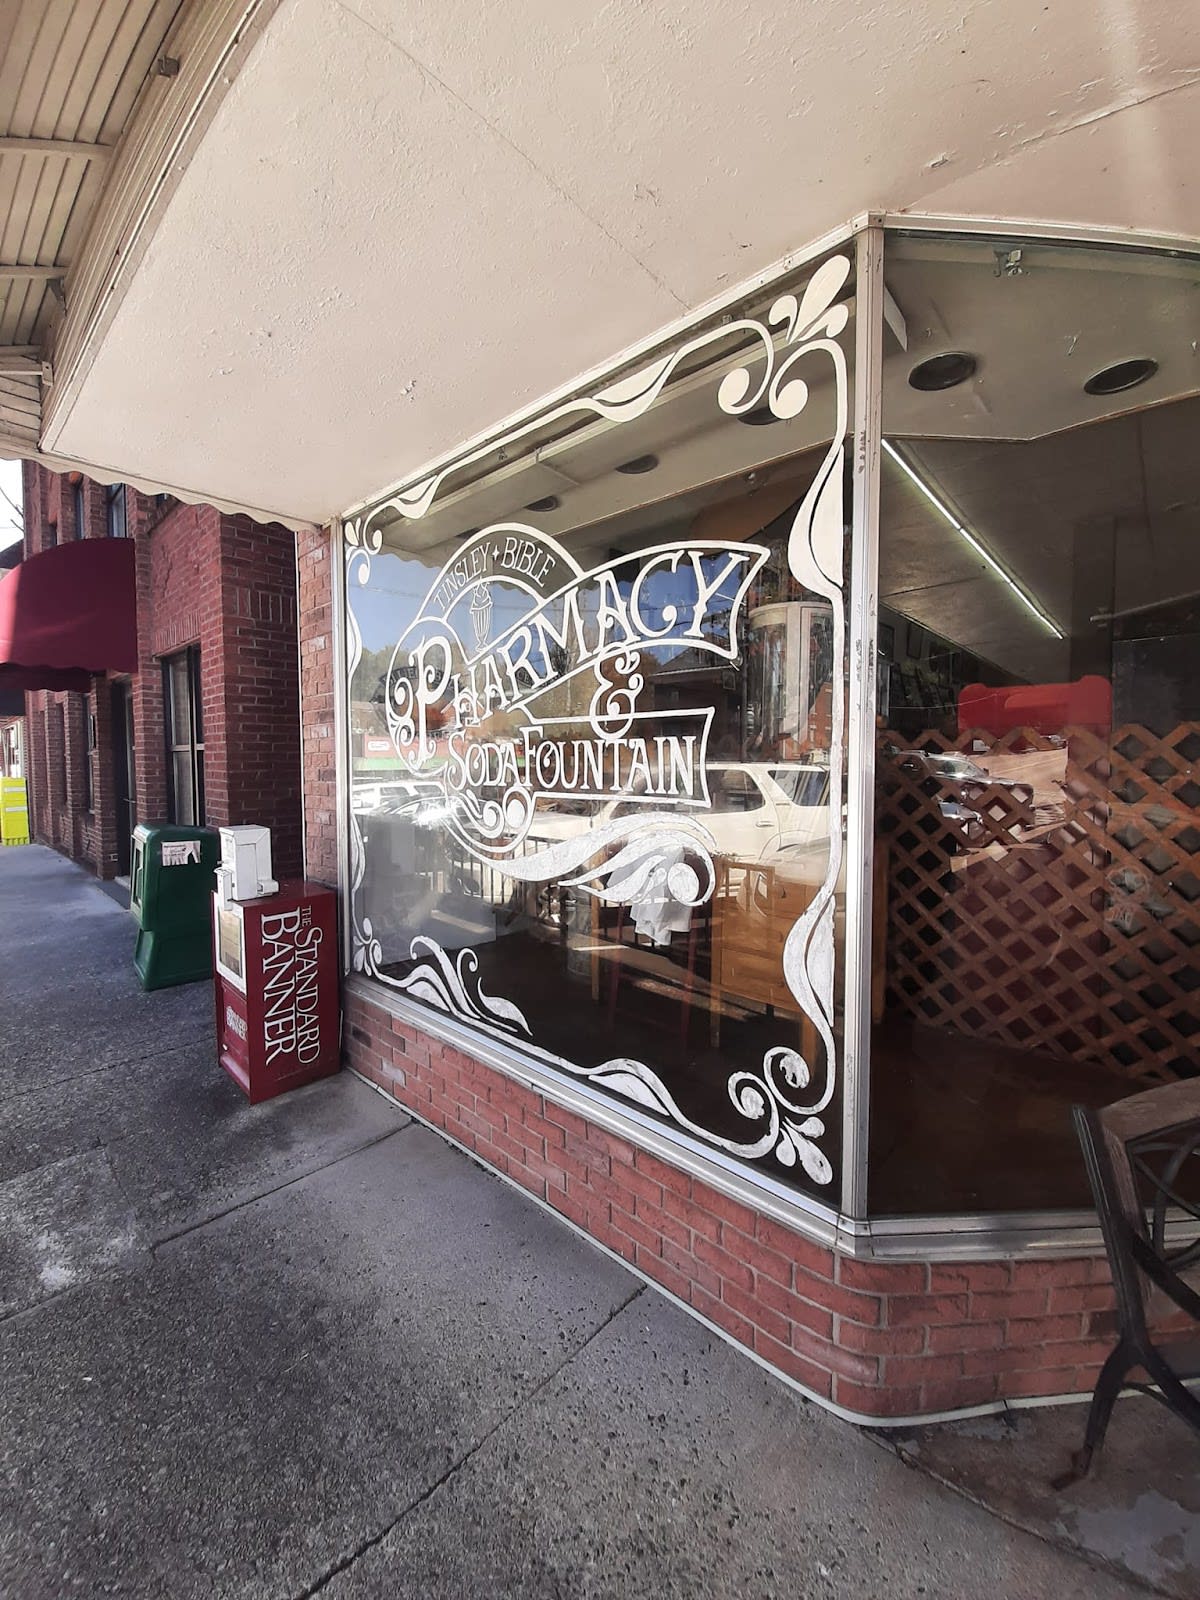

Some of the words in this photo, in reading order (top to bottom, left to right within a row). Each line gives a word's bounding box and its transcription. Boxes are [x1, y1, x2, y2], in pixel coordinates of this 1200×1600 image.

[433, 542, 491, 611] TINSLEY
[500, 536, 557, 588] BIBLE
[408, 549, 750, 769] PHARMACY
[589, 643, 644, 740] &
[447, 728, 521, 791] SODA
[519, 724, 698, 796] FOUNTAIN
[301, 905, 312, 928] THE
[261, 906, 300, 1066] BANNER
[294, 926, 324, 1065] STANDARD
